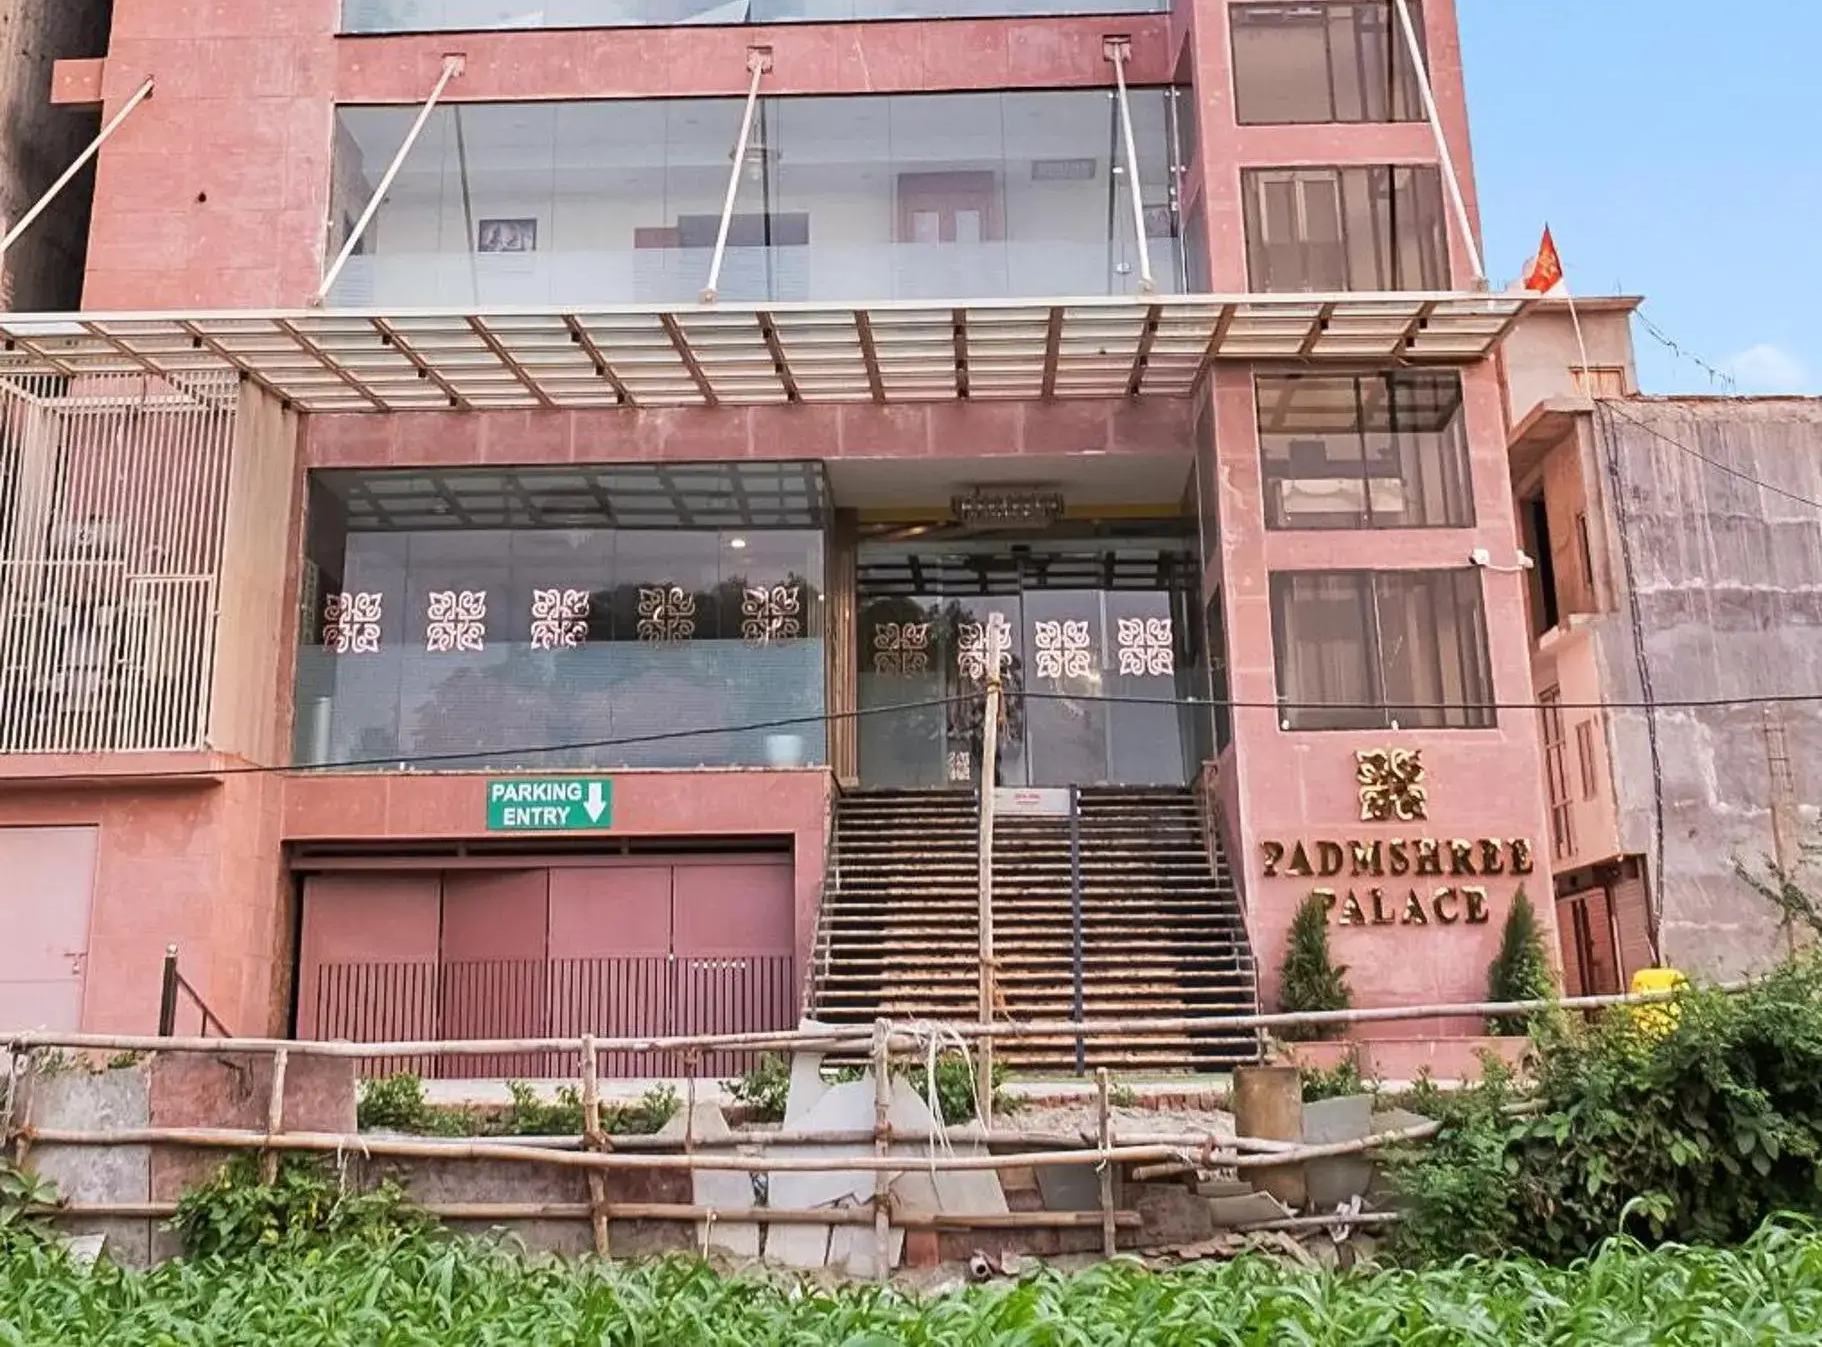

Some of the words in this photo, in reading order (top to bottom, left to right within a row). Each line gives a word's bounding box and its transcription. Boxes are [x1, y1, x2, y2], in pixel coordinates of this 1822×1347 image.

[491, 782, 582, 803] PARKING
[503, 806, 571, 826] ENTRY
[1260, 837, 1534, 877] PADMSHREE
